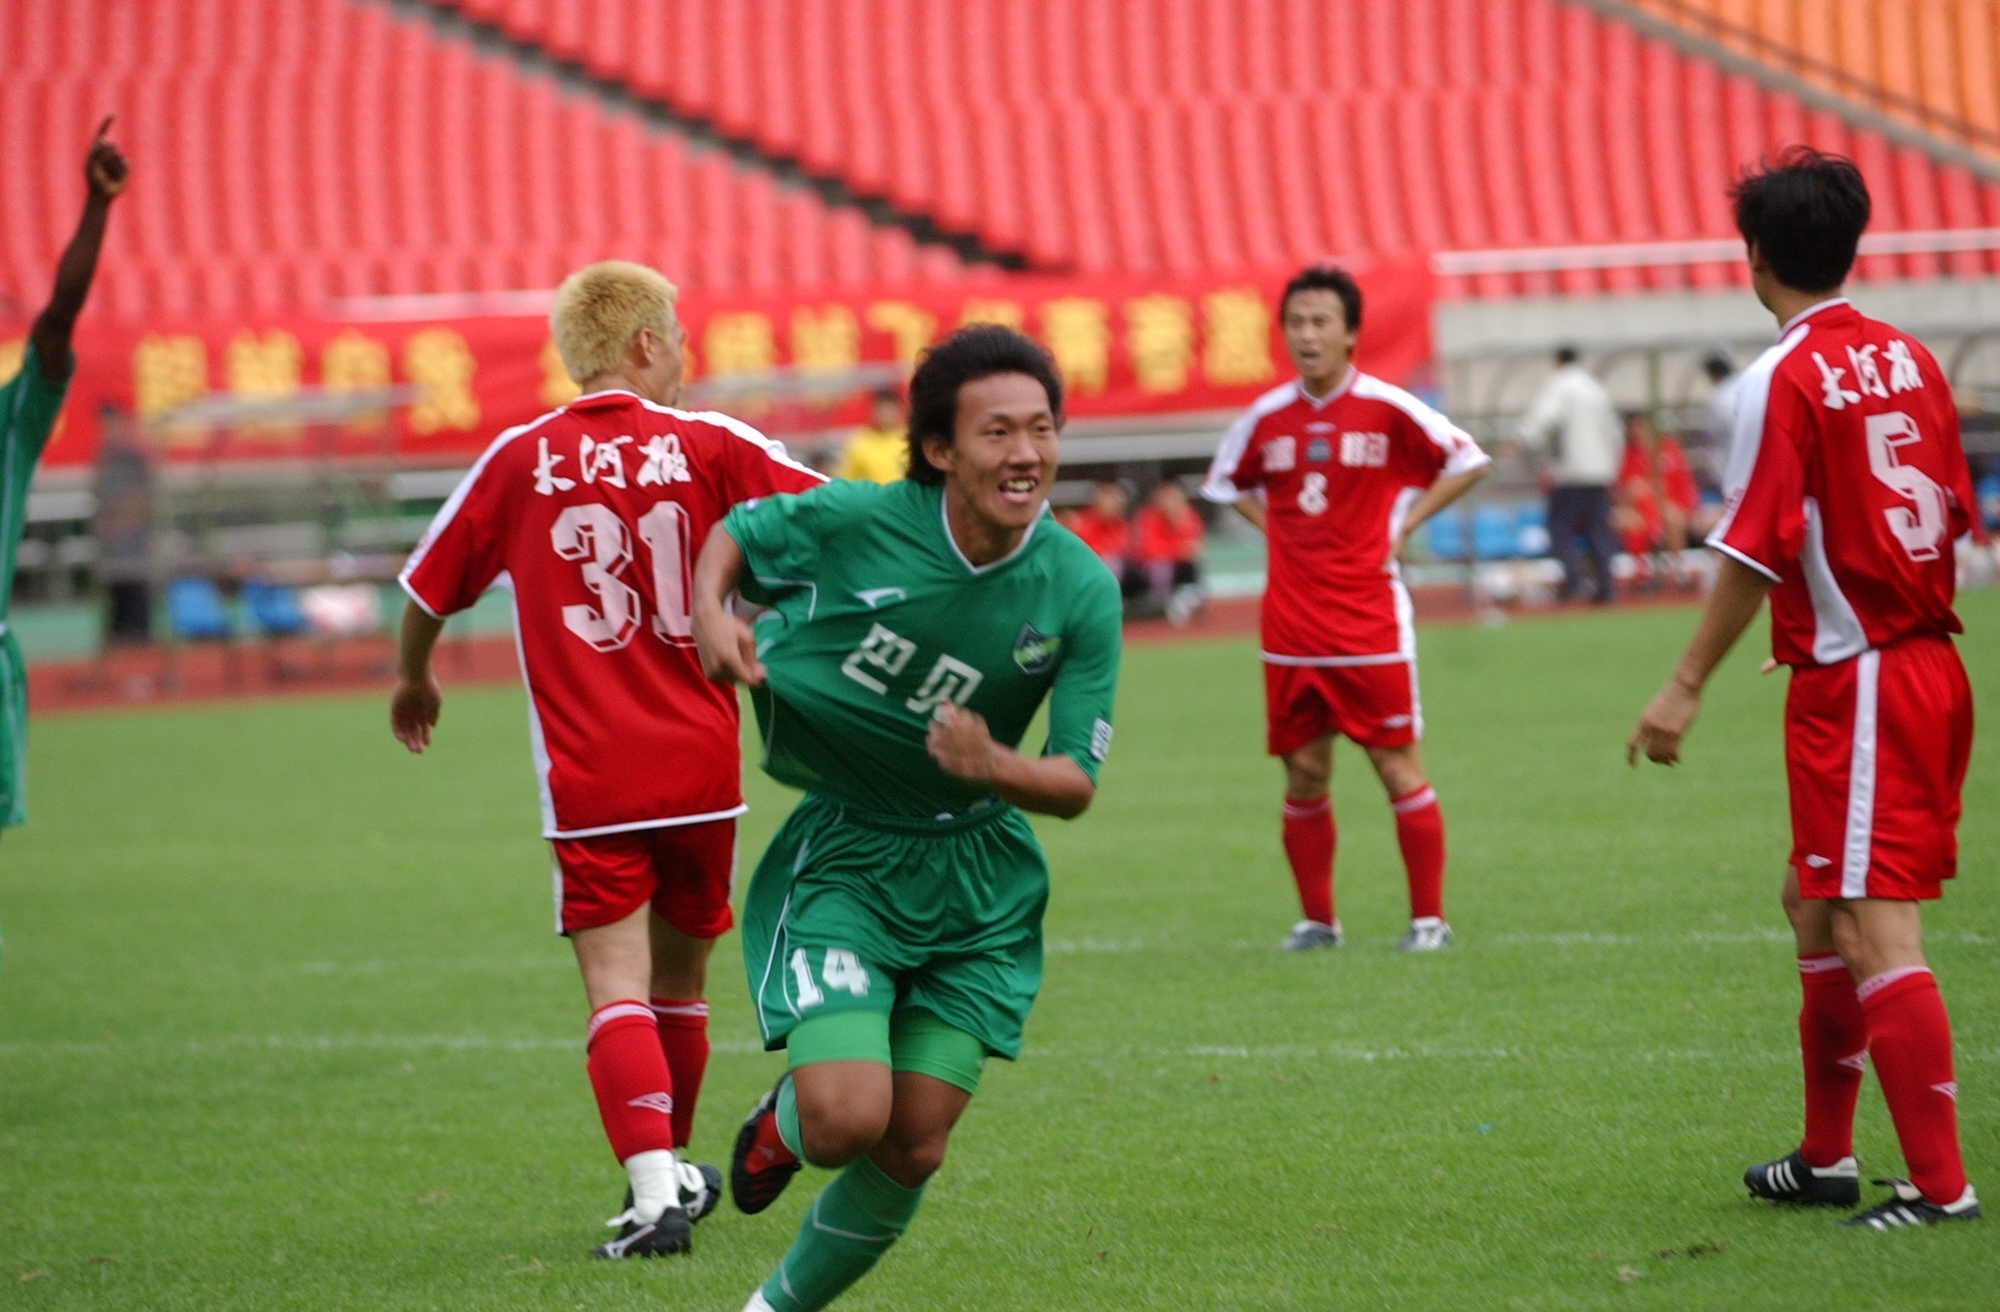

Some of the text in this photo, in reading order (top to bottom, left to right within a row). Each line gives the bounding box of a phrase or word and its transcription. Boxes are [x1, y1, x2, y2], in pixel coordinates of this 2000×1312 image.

[1298, 472, 1329, 516] 8
[1864, 410, 1948, 562] 5
[550, 501, 700, 652] 31
[790, 947, 870, 1010] 14
